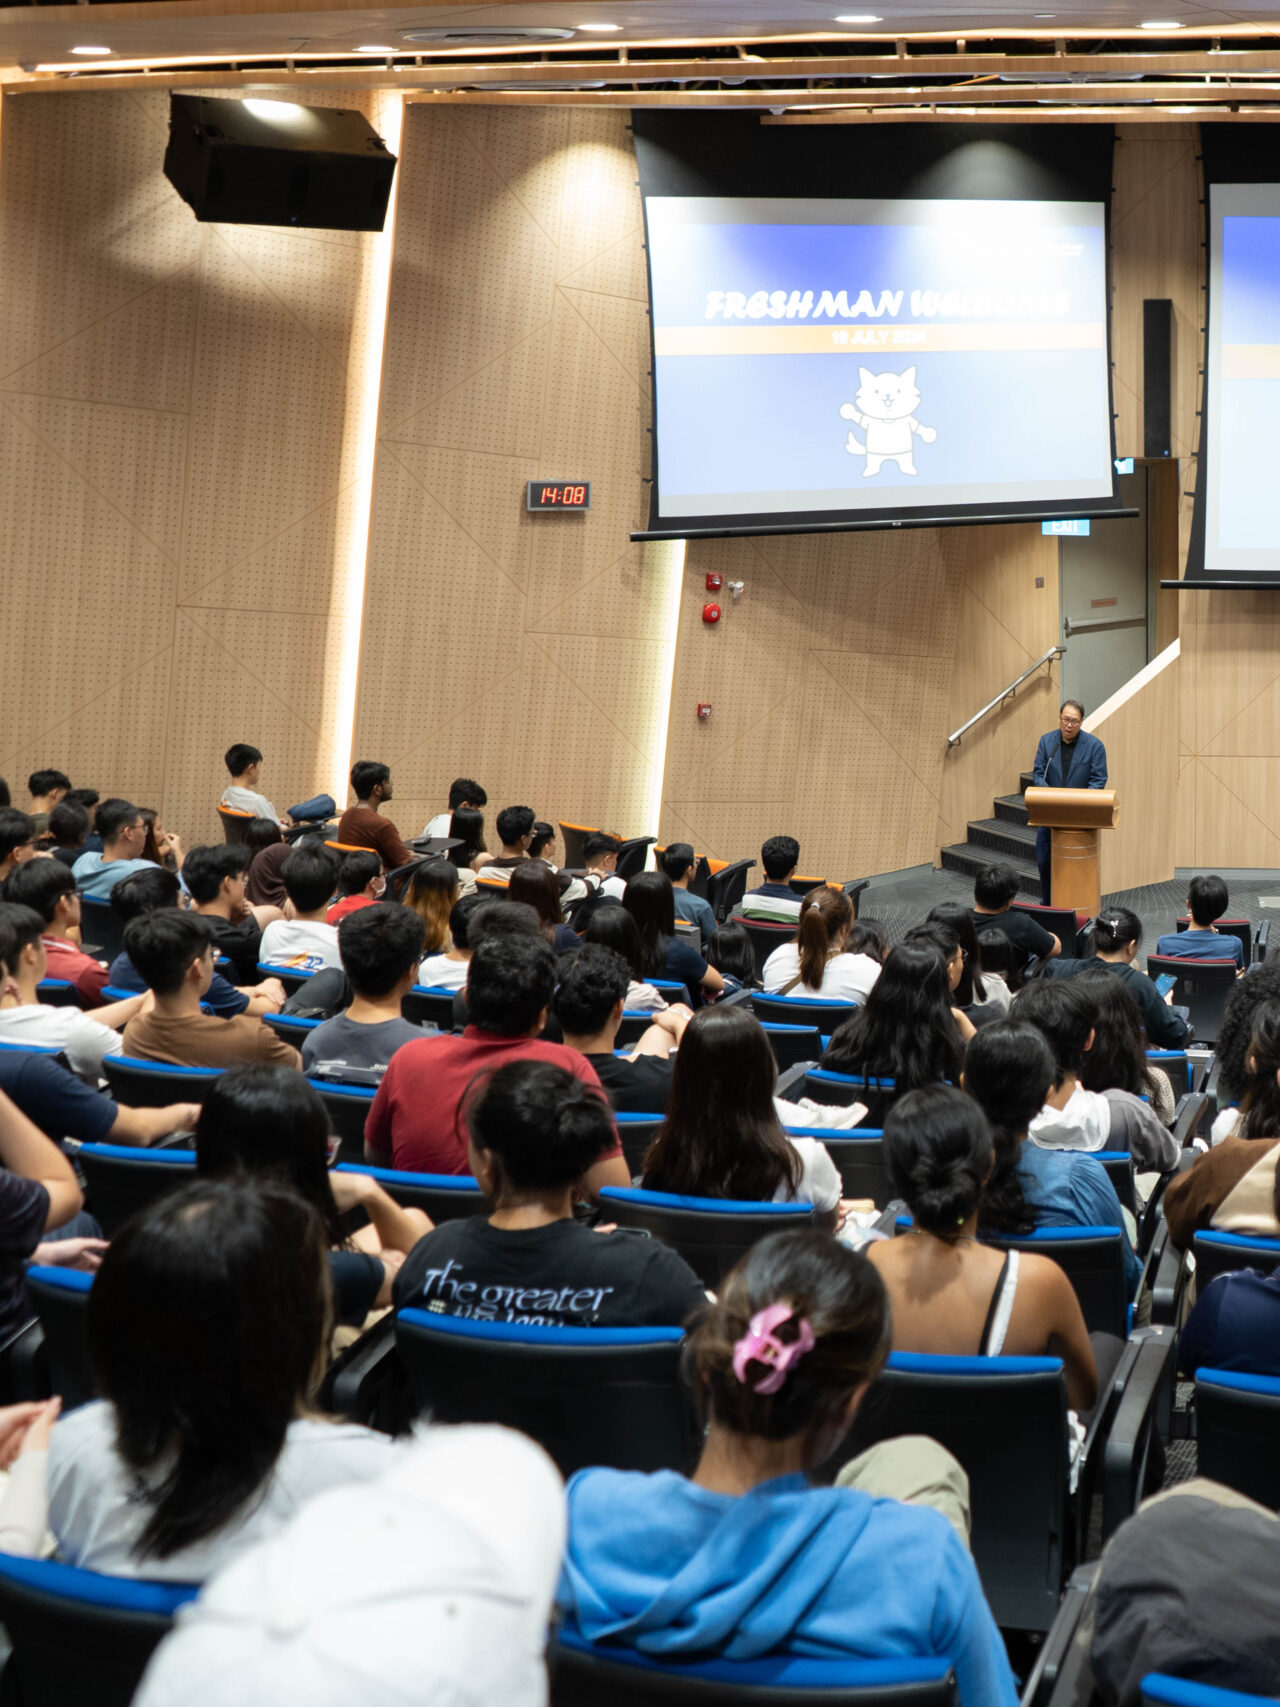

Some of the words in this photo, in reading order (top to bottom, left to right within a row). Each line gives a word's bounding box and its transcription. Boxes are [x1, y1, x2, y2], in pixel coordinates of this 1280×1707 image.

[704, 289, 904, 319] FRESHMAN
[831, 330, 849, 344] 19
[851, 329, 890, 344] JULY
[540, 486, 586, 504] 14:08
[1051, 520, 1078, 532] EXIT
[423, 1258, 477, 1301] The
[481, 1285, 614, 1316] greater
